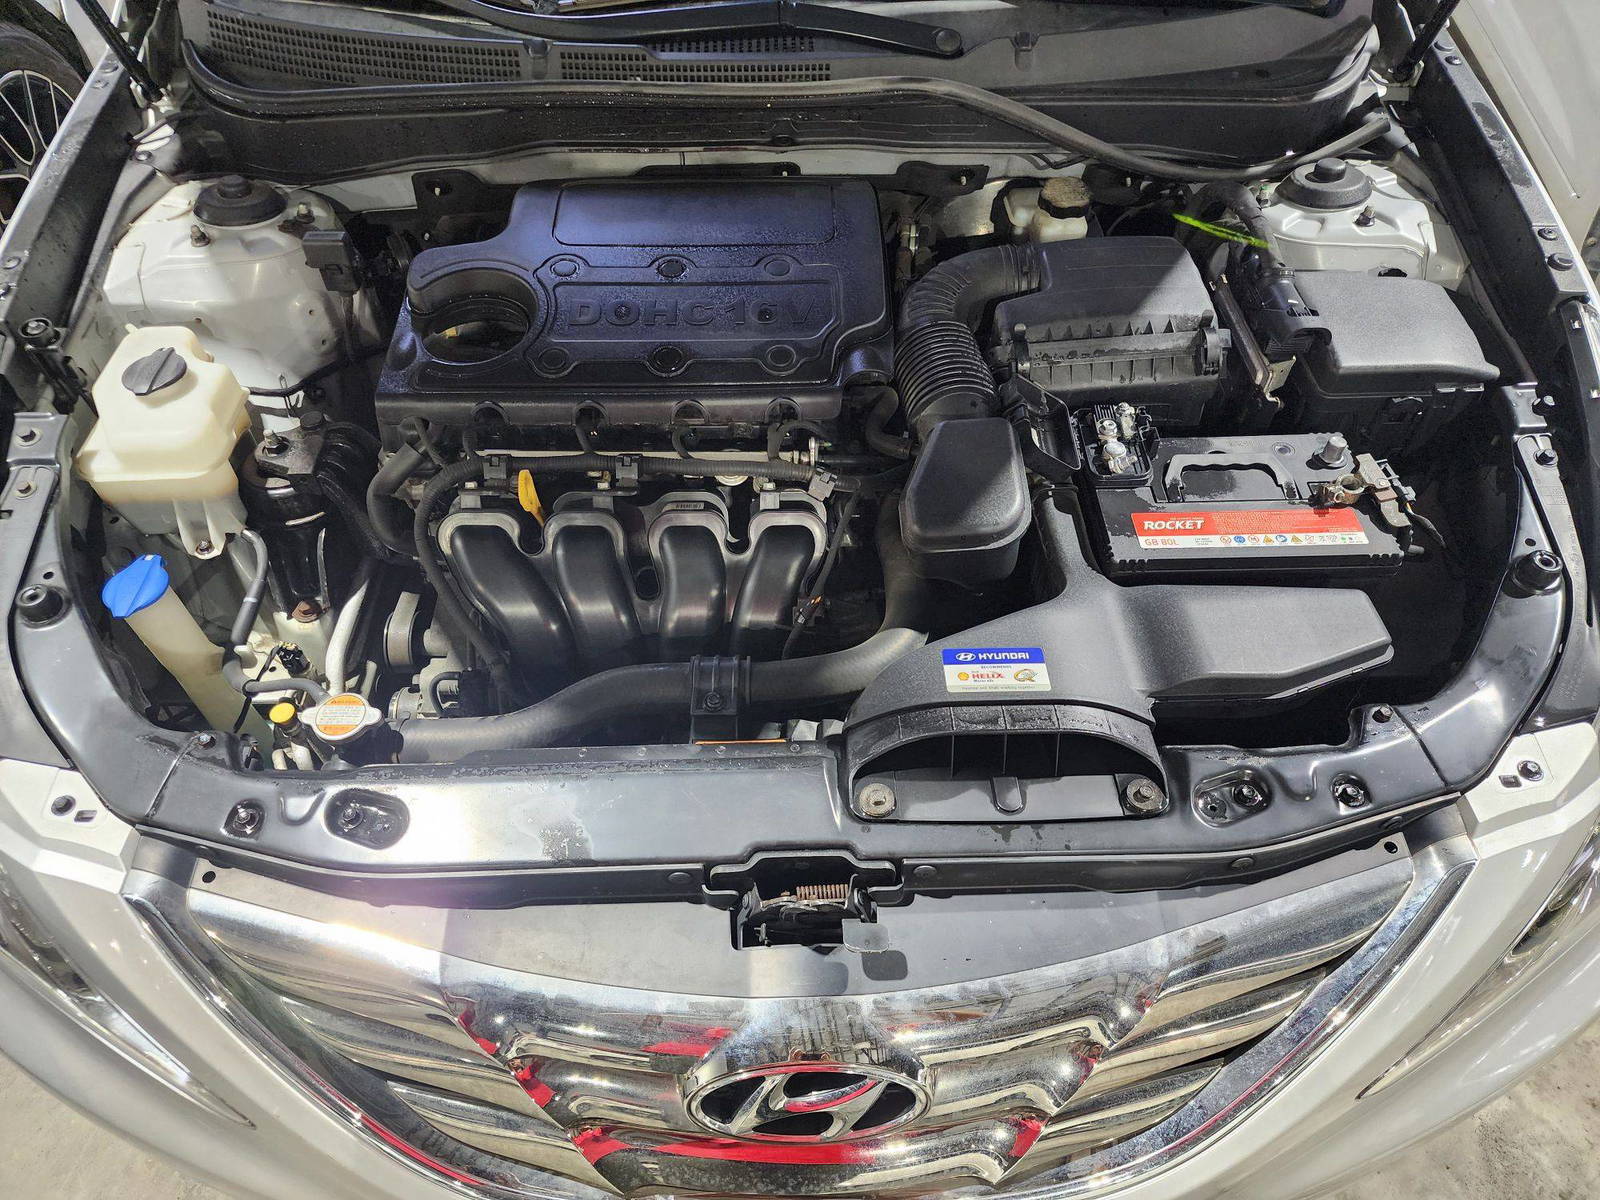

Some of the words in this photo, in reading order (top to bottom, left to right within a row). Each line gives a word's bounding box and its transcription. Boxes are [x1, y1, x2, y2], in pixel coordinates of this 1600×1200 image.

[569, 300, 714, 326] DOHC
[1143, 520, 1205, 531] ROCKET
[1145, 538, 1159, 546] GB
[978, 652, 1030, 660] HYUNDAI
